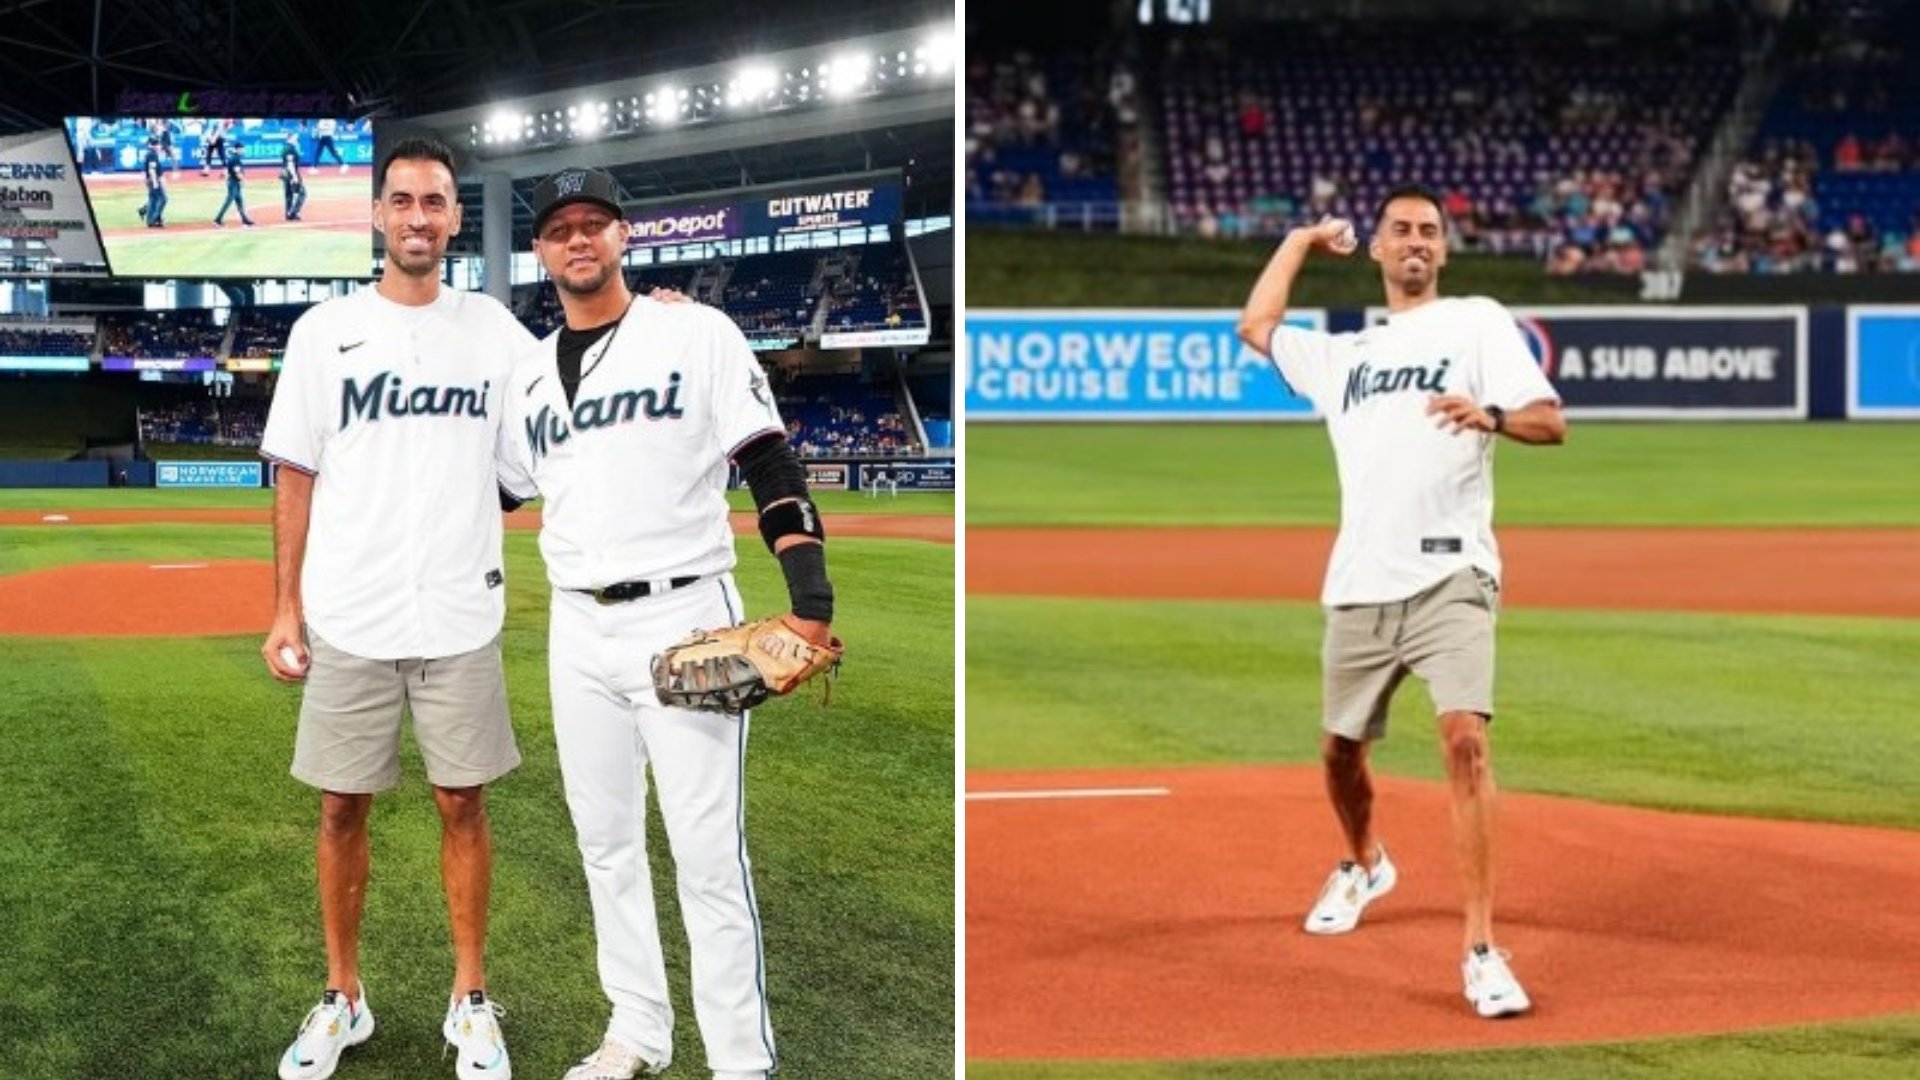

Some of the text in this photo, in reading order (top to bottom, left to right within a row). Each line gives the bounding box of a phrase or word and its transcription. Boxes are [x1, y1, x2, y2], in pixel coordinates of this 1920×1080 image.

[768, 190, 870, 218] CUTWATER
[978, 332, 1270, 370] NORWEGIA
[1559, 347, 1775, 379] A SUB ABOVE
[339, 371, 491, 432] Miami
[977, 370, 1241, 399] CRUISE LINE
[1342, 358, 1450, 413] Miami
[525, 372, 683, 457] Miami
